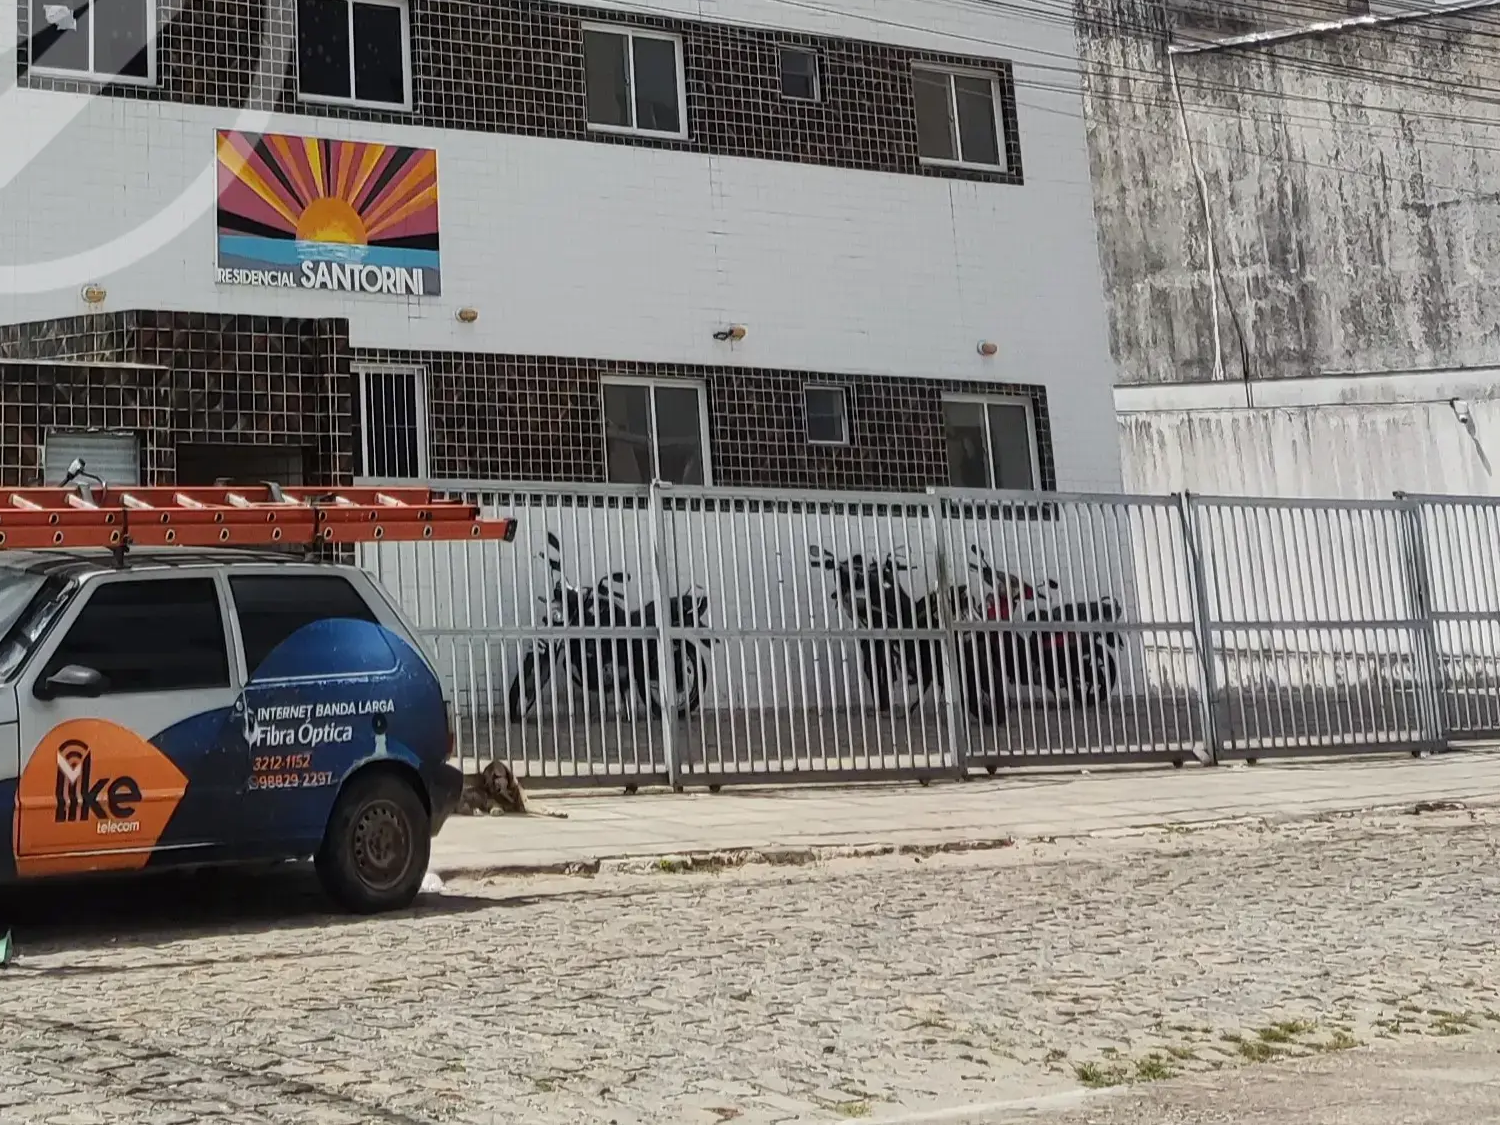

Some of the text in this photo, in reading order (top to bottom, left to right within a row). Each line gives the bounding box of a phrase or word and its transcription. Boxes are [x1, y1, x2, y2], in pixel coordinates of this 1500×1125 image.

[217, 260, 424, 295] RESIDENCIAL SANTORINI
[257, 699, 395, 721] INTERNET BANDA LARGA
[257, 719, 353, 747] Fibra Óptica
[97, 819, 140, 835] telecom
